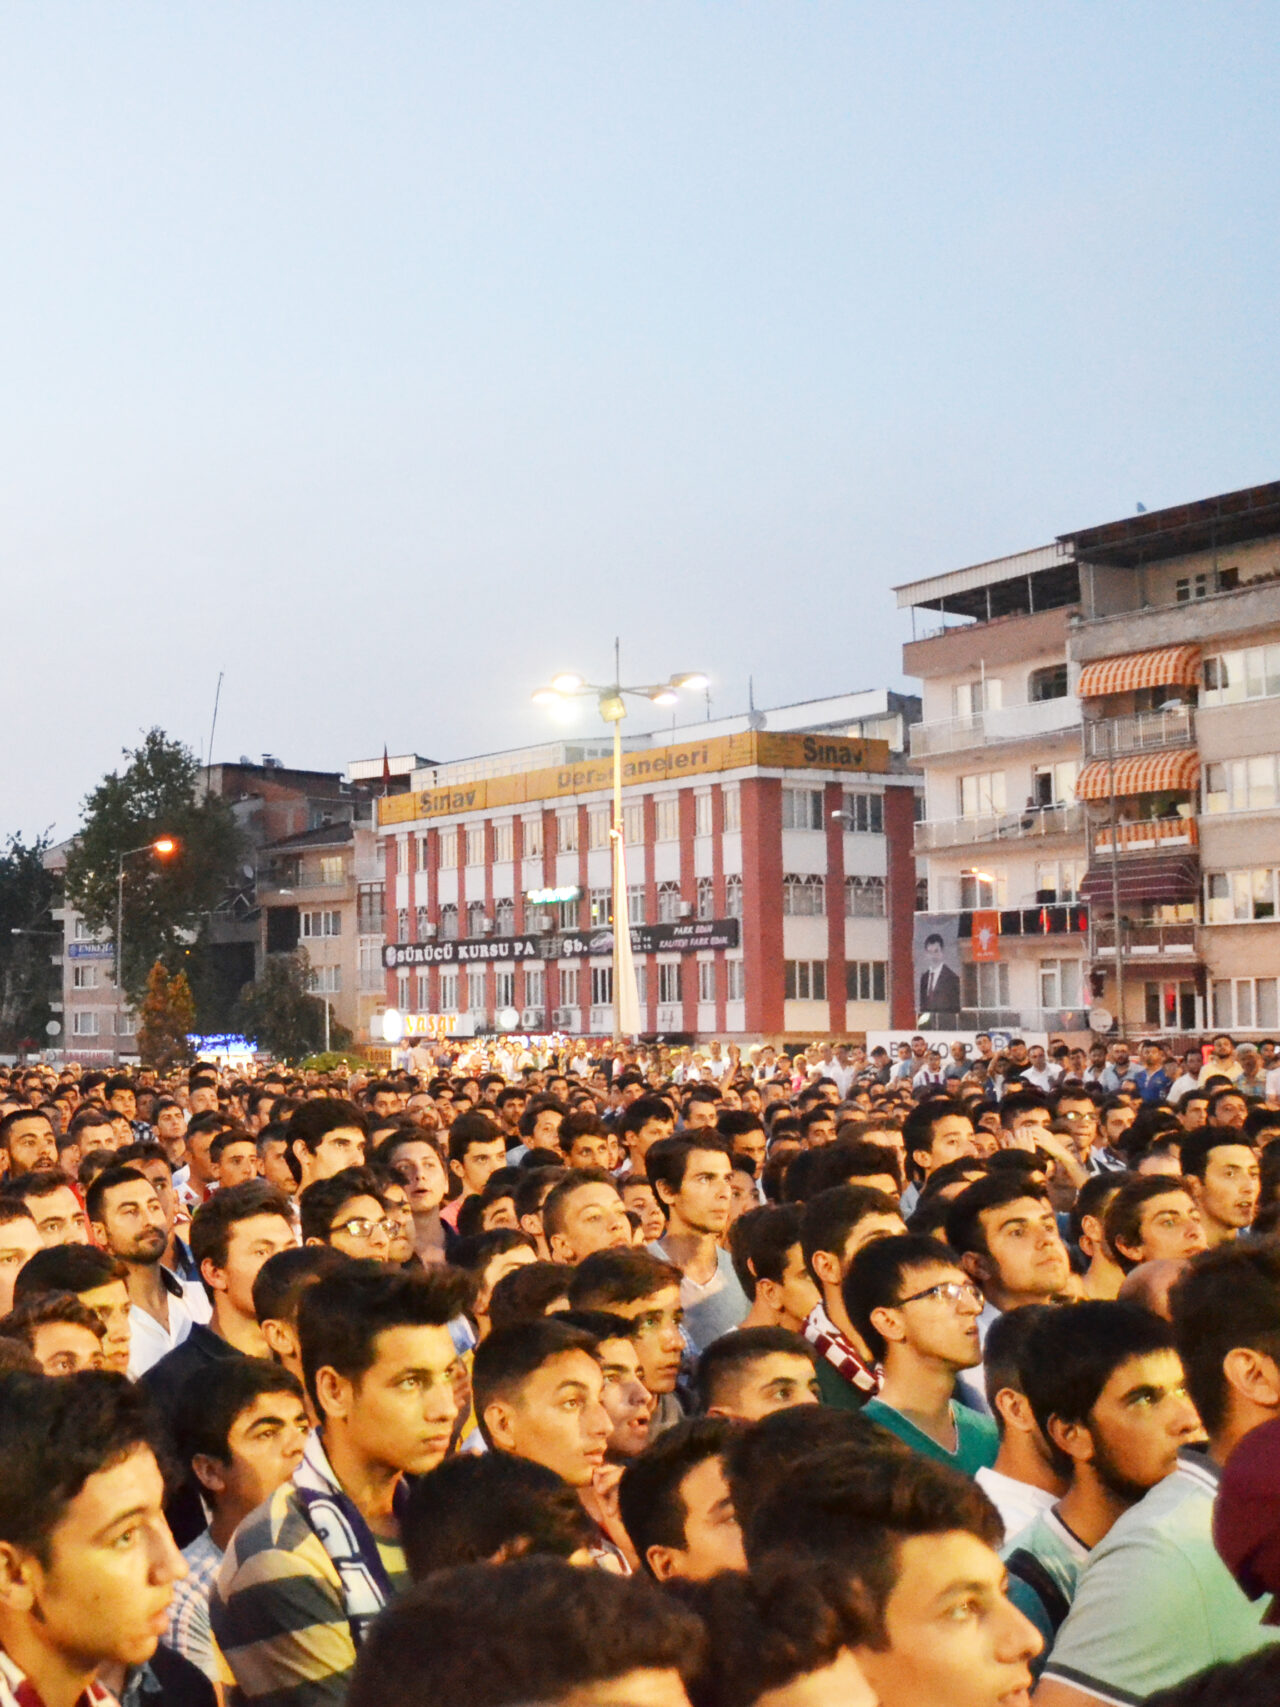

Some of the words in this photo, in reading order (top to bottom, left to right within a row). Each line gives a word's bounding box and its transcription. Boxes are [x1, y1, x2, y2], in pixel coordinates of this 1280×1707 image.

[420, 788, 476, 814] Sınav
[397, 944, 454, 962] SÜRÜCÜ
[458, 942, 510, 960] KURSU
